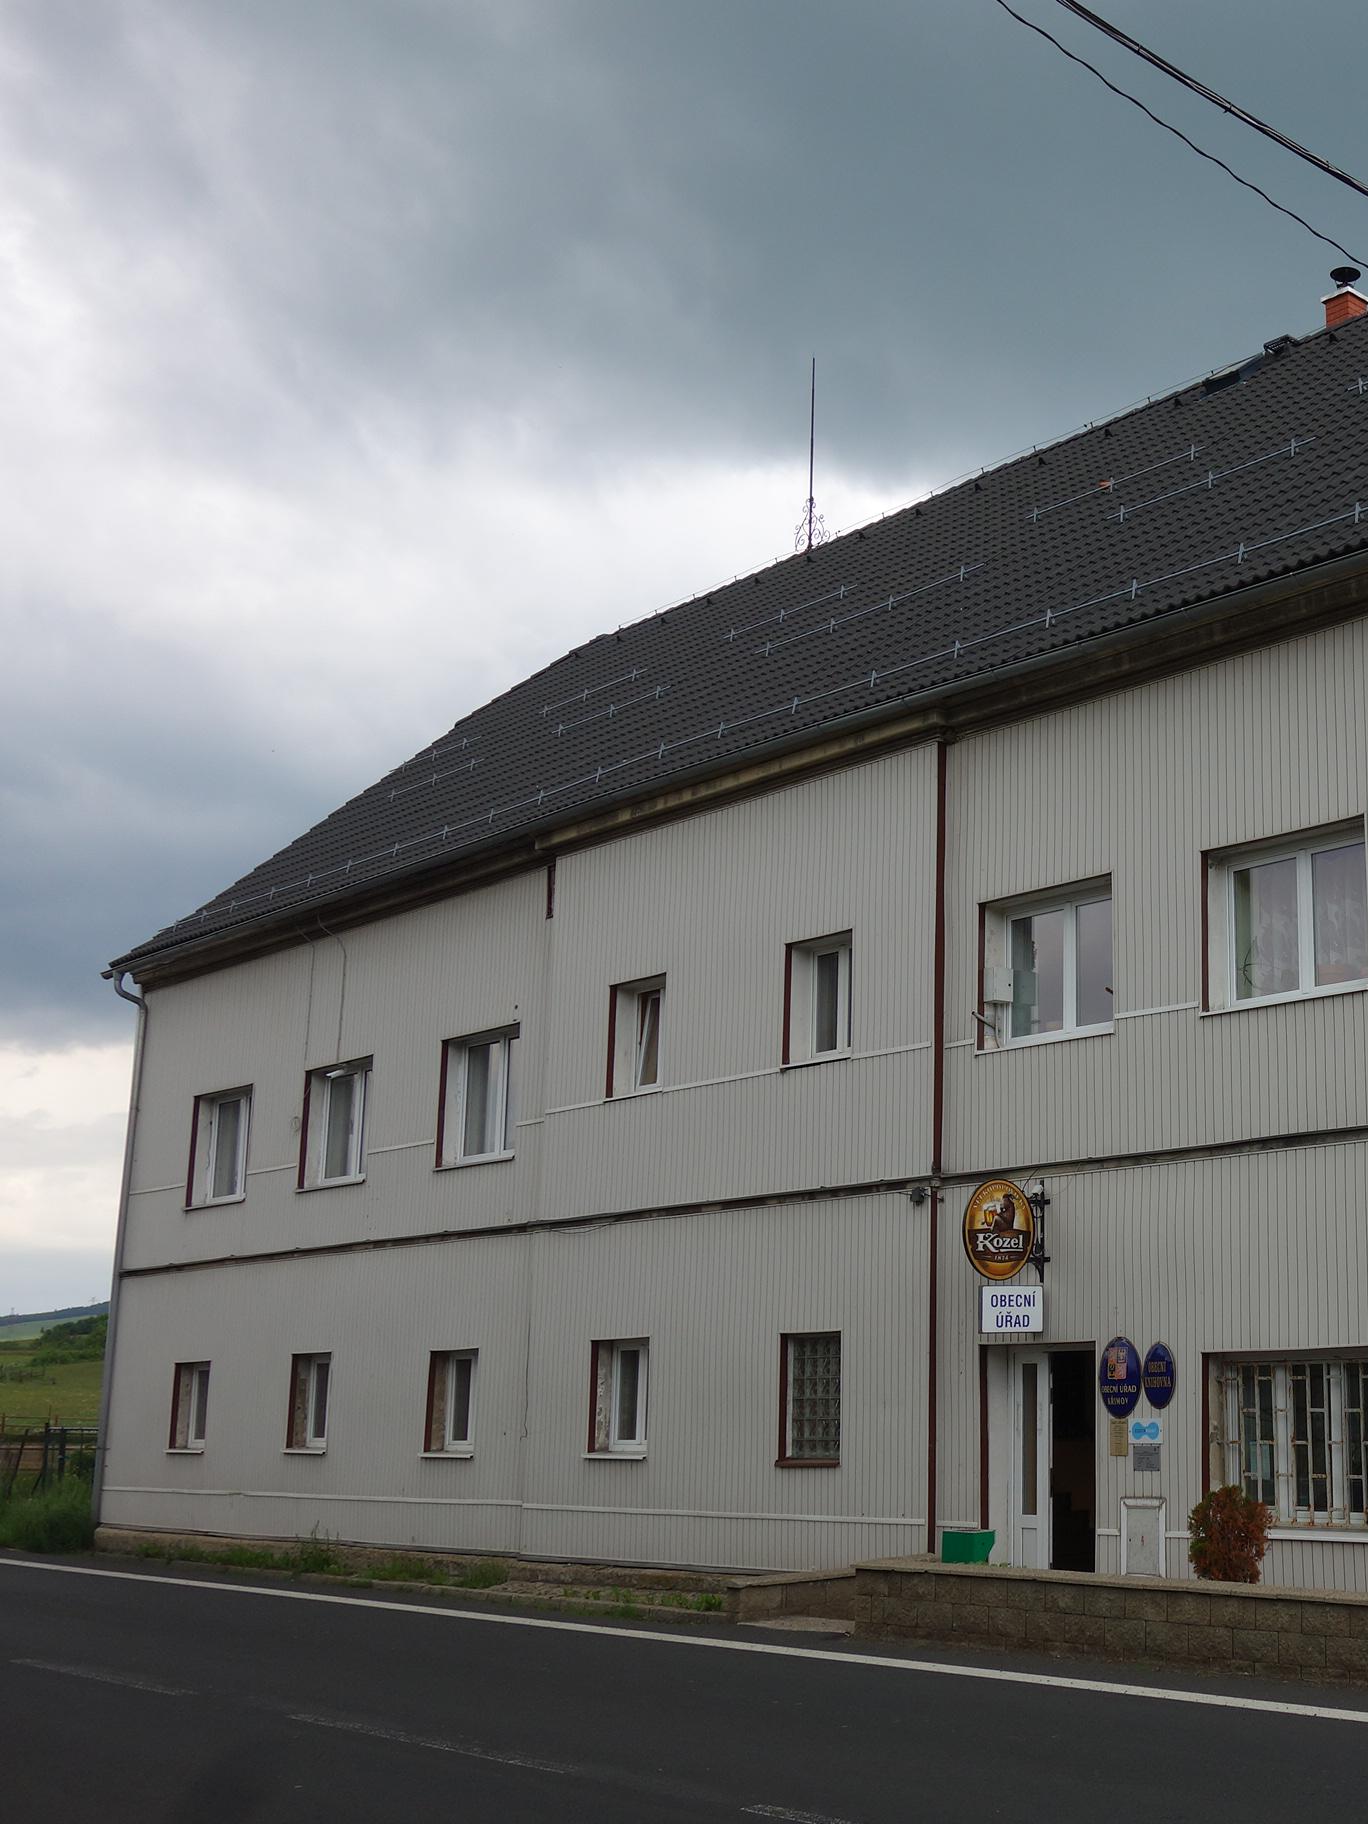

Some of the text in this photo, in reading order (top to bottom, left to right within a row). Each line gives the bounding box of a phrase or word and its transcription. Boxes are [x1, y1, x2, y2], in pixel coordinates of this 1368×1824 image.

[975, 1233, 1024, 1253] Kozel
[990, 1291, 1036, 1307] OBECNÍ
[996, 1312, 1030, 1328] ÚŘAD
[1119, 1383, 1136, 1392] ÚŘAD
[1145, 1376, 1171, 1388] KNIHOVNA
